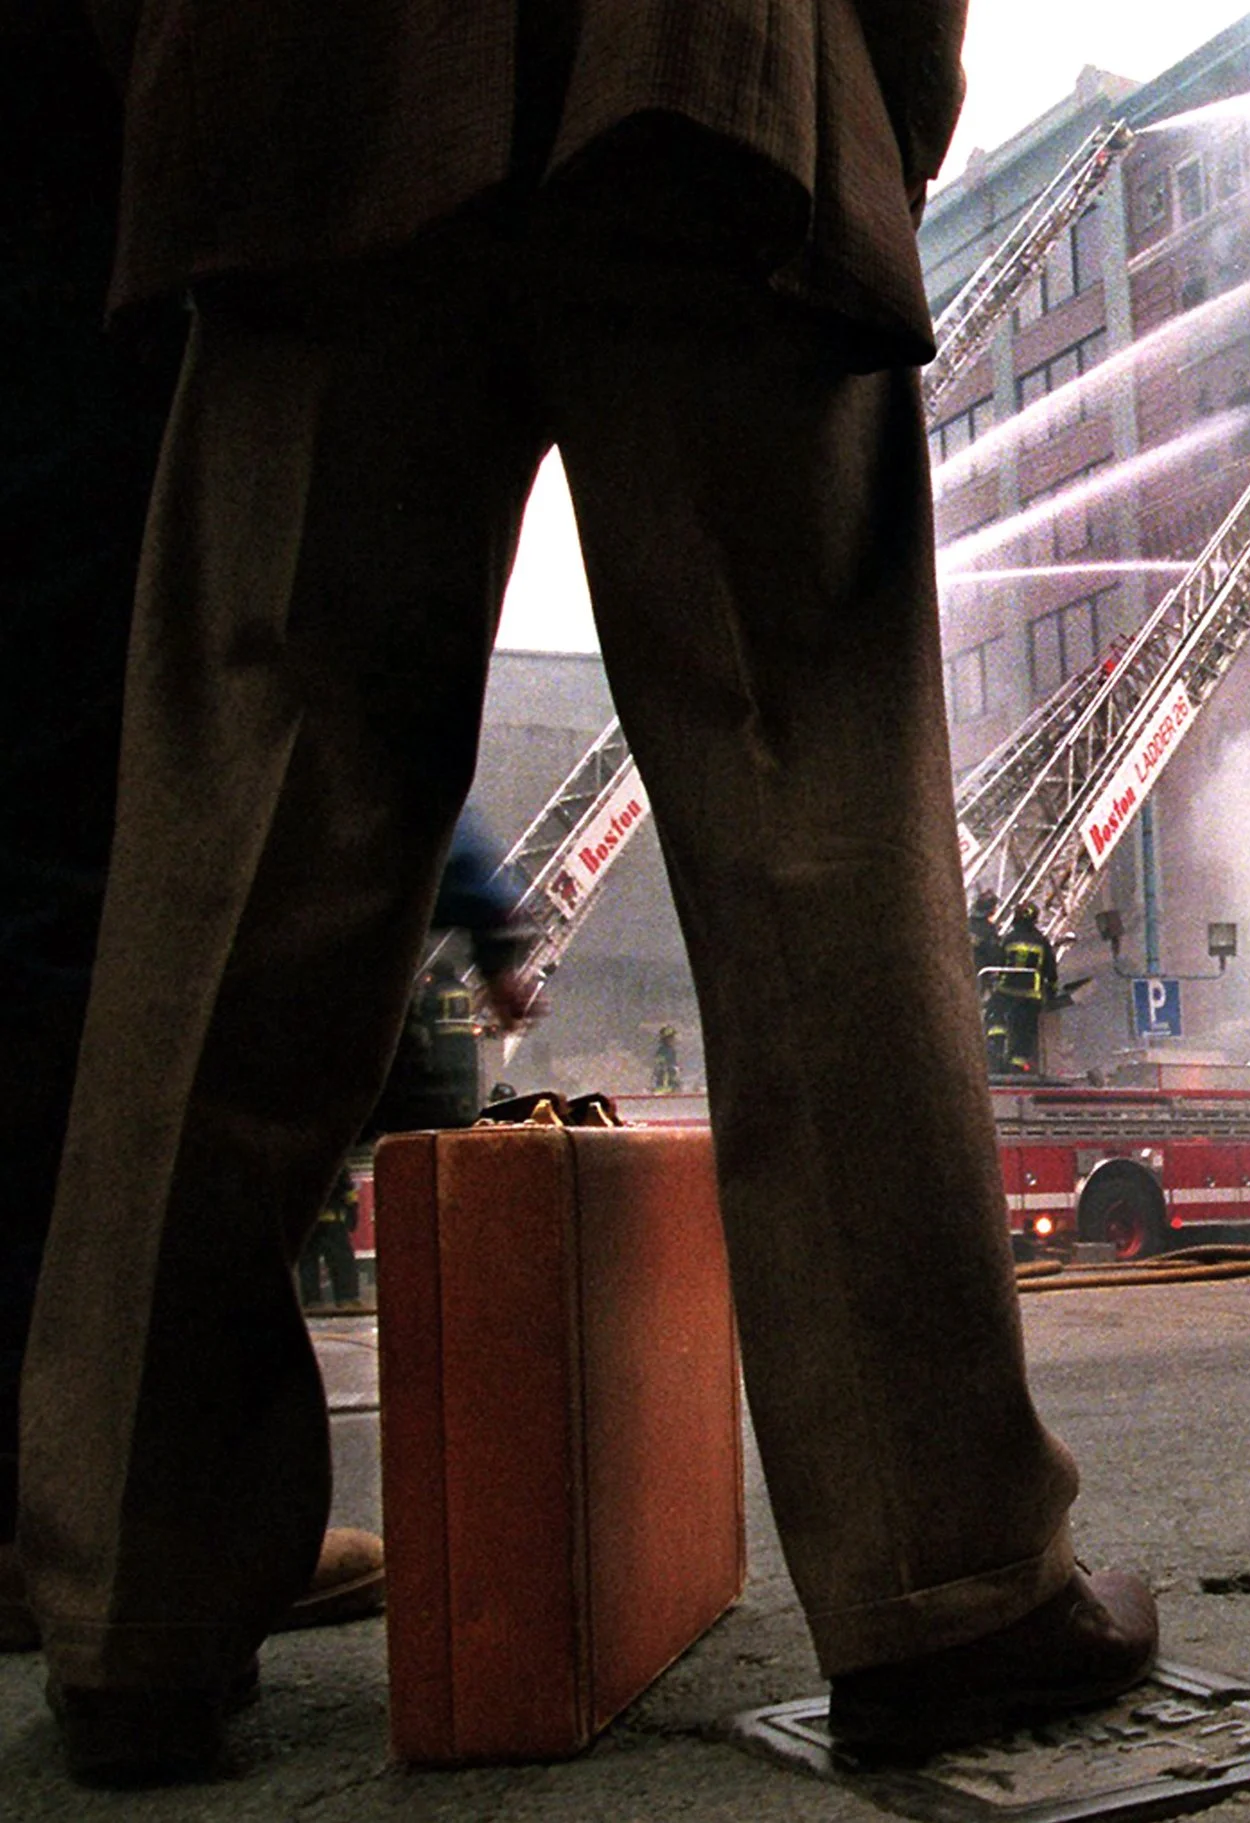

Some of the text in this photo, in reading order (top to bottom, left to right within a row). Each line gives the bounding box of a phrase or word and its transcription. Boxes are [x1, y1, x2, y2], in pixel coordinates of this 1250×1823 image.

[1089, 786, 1137, 855] Boston
[1134, 716, 1178, 784] LADDER
[579, 799, 642, 875] Boston
[1148, 979, 1167, 1022] P
